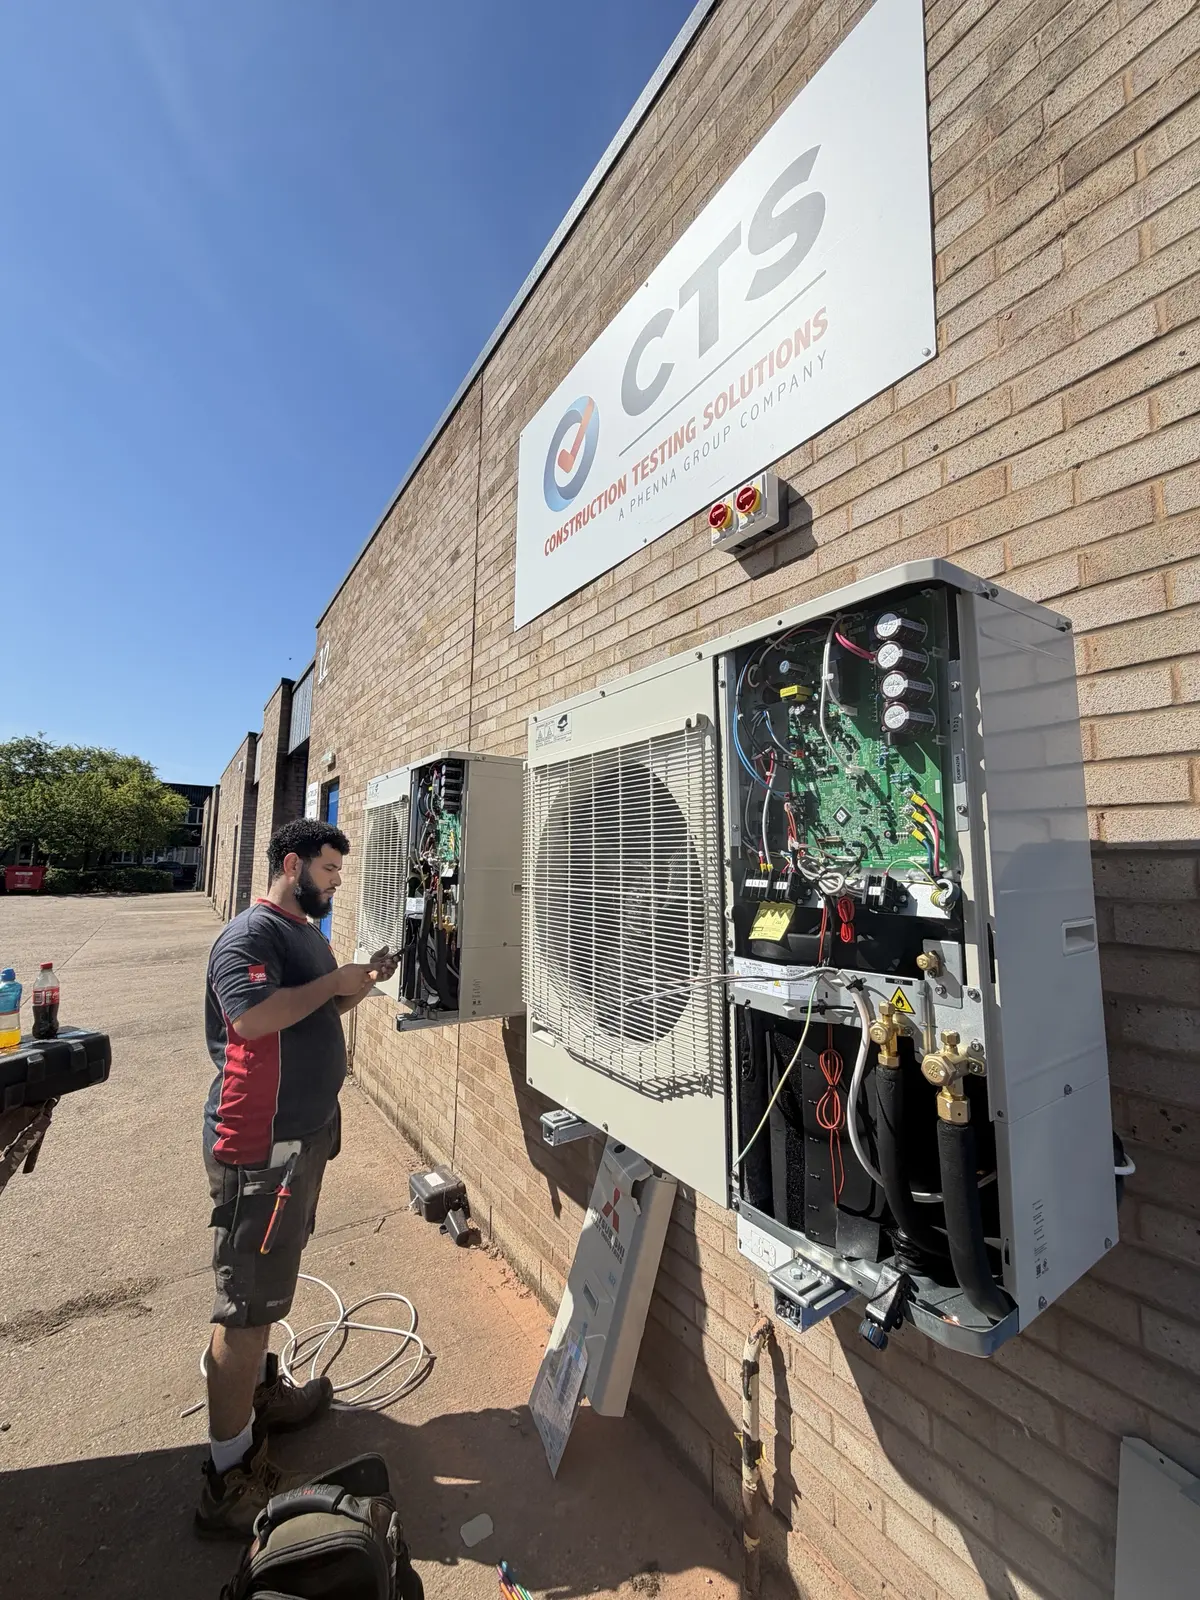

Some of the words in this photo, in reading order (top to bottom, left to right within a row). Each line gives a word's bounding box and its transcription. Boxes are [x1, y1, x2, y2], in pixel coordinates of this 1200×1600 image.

[620, 143, 826, 417] CTS
[544, 473, 628, 557] CONSTRUCTION
[631, 416, 697, 487] TESTING
[703, 305, 829, 431] SOLUTIONS
[618, 507, 625, 521] A
[630, 468, 677, 513] PHENNA
[683, 425, 731, 472] GROUP
[740, 349, 827, 429] COMPANY
[317, 640, 330, 686] 12
[591, 1206, 626, 1258] MTSUBSHI
